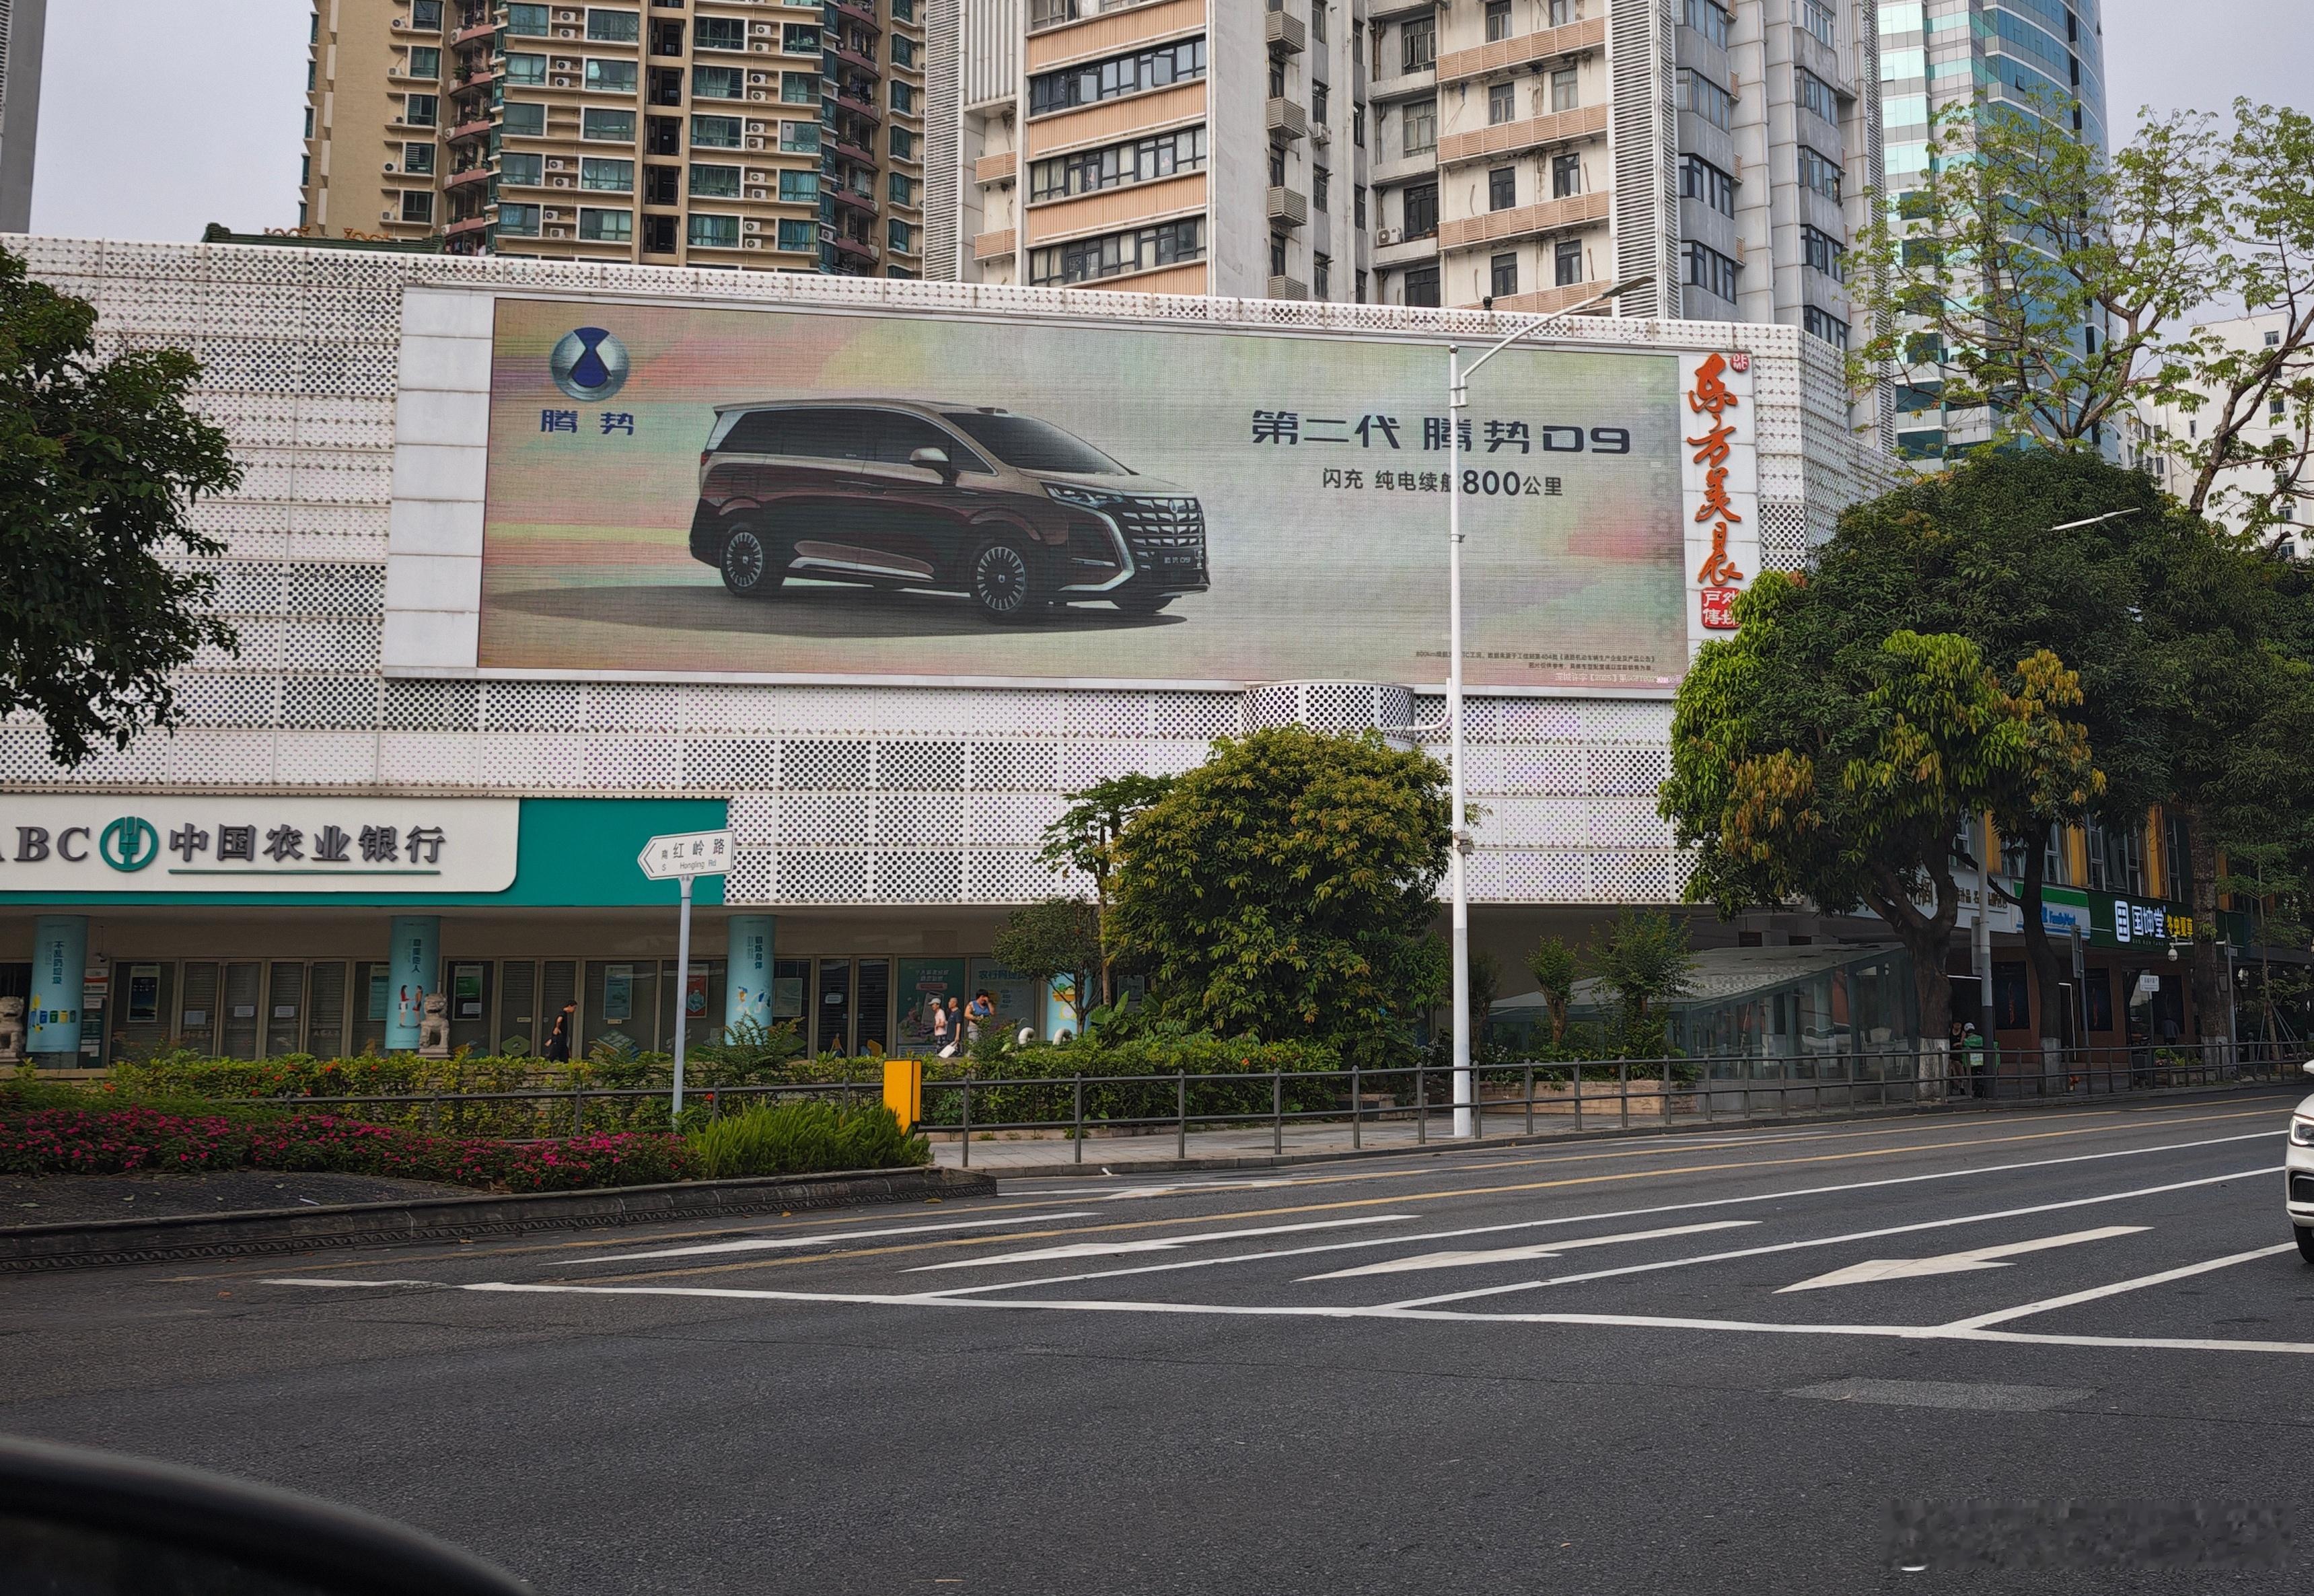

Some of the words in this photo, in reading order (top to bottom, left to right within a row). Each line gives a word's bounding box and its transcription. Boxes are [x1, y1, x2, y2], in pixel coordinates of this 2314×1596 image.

[540, 409, 634, 435] 腾势
[1252, 410, 1400, 449] 第二代
[1424, 417, 1630, 454] 腾势D9
[1323, 468, 1363, 490] 闪充
[0, 826, 89, 862] BC
[170, 823, 445, 863] 中国农业银行
[661, 849, 668, 860] 南
[673, 838, 725, 859] 红岭路
[680, 861, 705, 870] Hongling
[2132, 905, 2165, 938] 国坤堂
